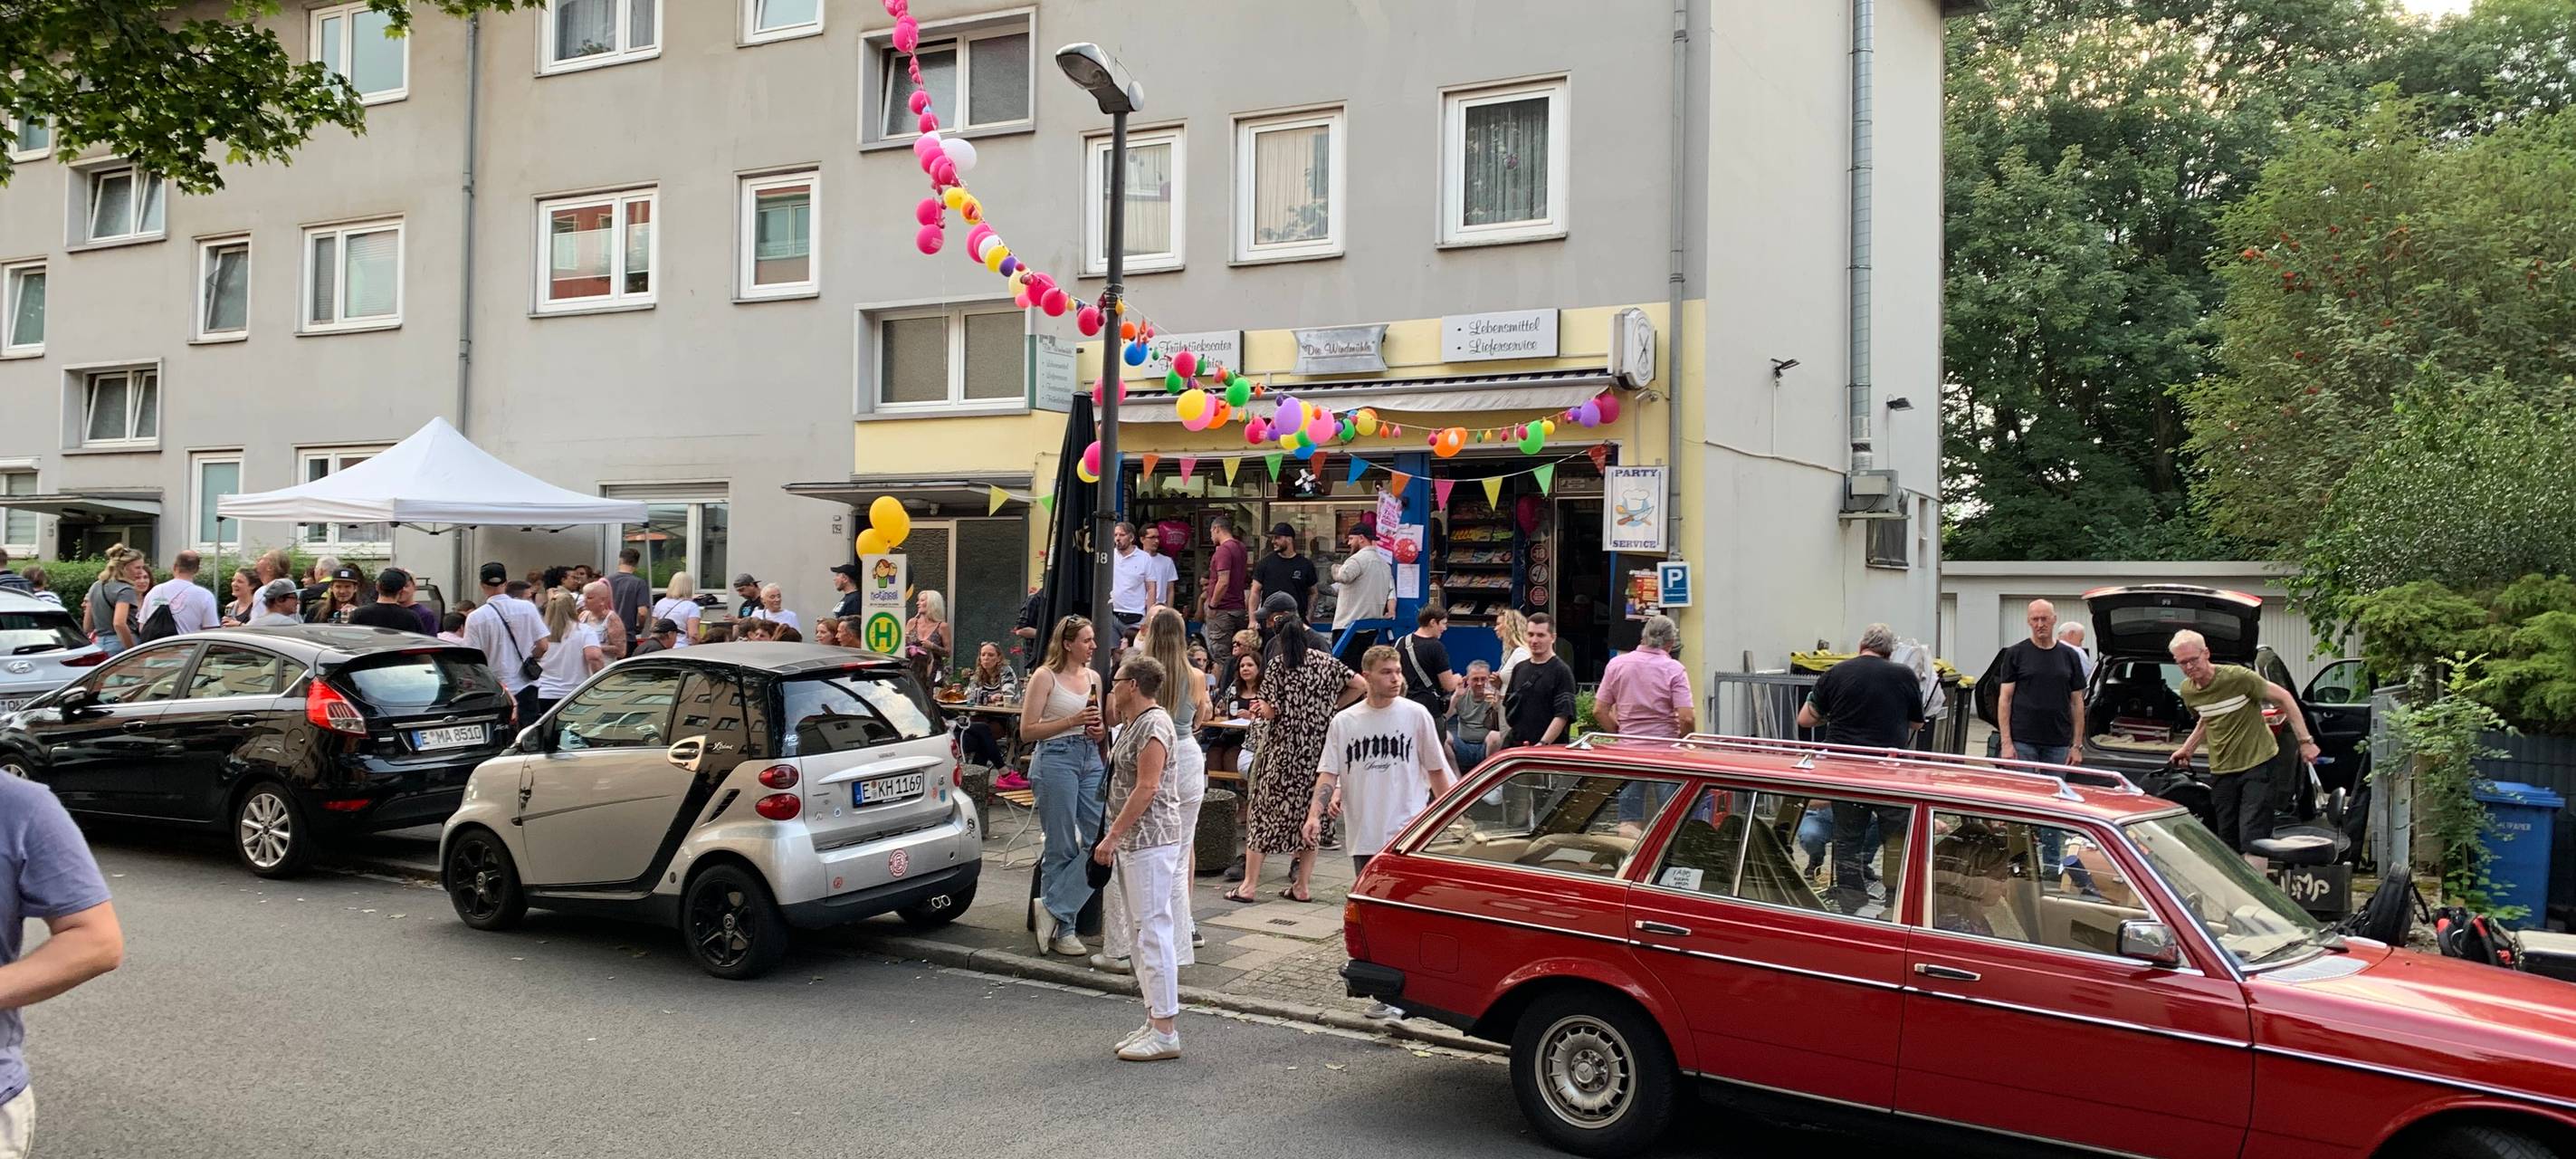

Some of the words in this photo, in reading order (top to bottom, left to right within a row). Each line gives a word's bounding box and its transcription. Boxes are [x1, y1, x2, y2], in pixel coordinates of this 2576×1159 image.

[1469, 317, 1541, 336] Lebensmittel
[1469, 338, 1538, 356] Lieferservice
[1615, 469, 1658, 477] PARTY
[1612, 540, 1656, 549] SERVICE
[1095, 551, 1108, 564] 18
[1667, 569, 1684, 588] P
[874, 622, 892, 647] H
[421, 732, 430, 745] E
[435, 730, 453, 743] MA
[453, 726, 482, 742] 8510
[863, 783, 871, 800] E
[878, 780, 894, 798] KH
[895, 775, 922, 794] 1169
